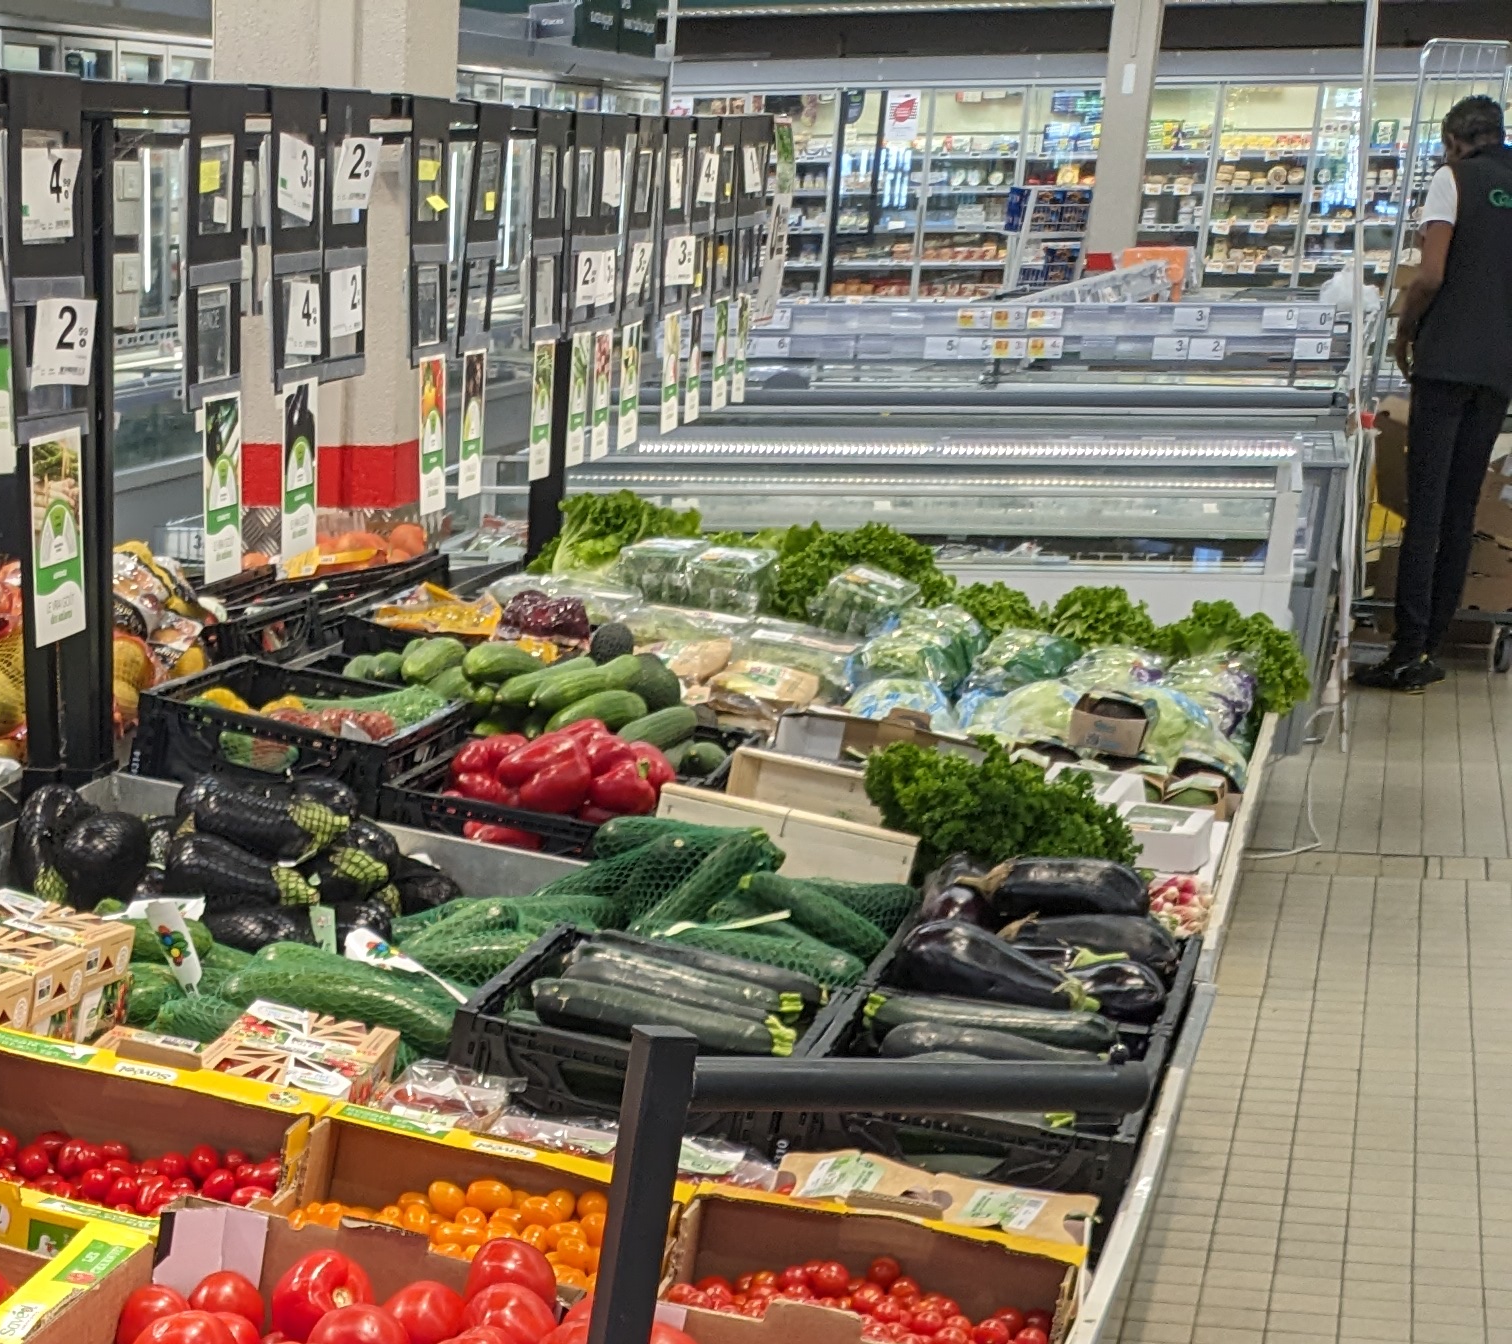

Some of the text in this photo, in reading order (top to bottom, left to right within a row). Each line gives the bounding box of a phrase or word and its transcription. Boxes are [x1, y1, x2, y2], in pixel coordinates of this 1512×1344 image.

[300, 149, 309, 189] 3
[348, 143, 366, 180] 2
[50, 158, 63, 204] 4
[582, 258, 592, 286] 2
[678, 241, 687, 265] 3
[302, 289, 312, 327] 4
[350, 273, 357, 311] 2
[55, 305, 77, 350] 2
